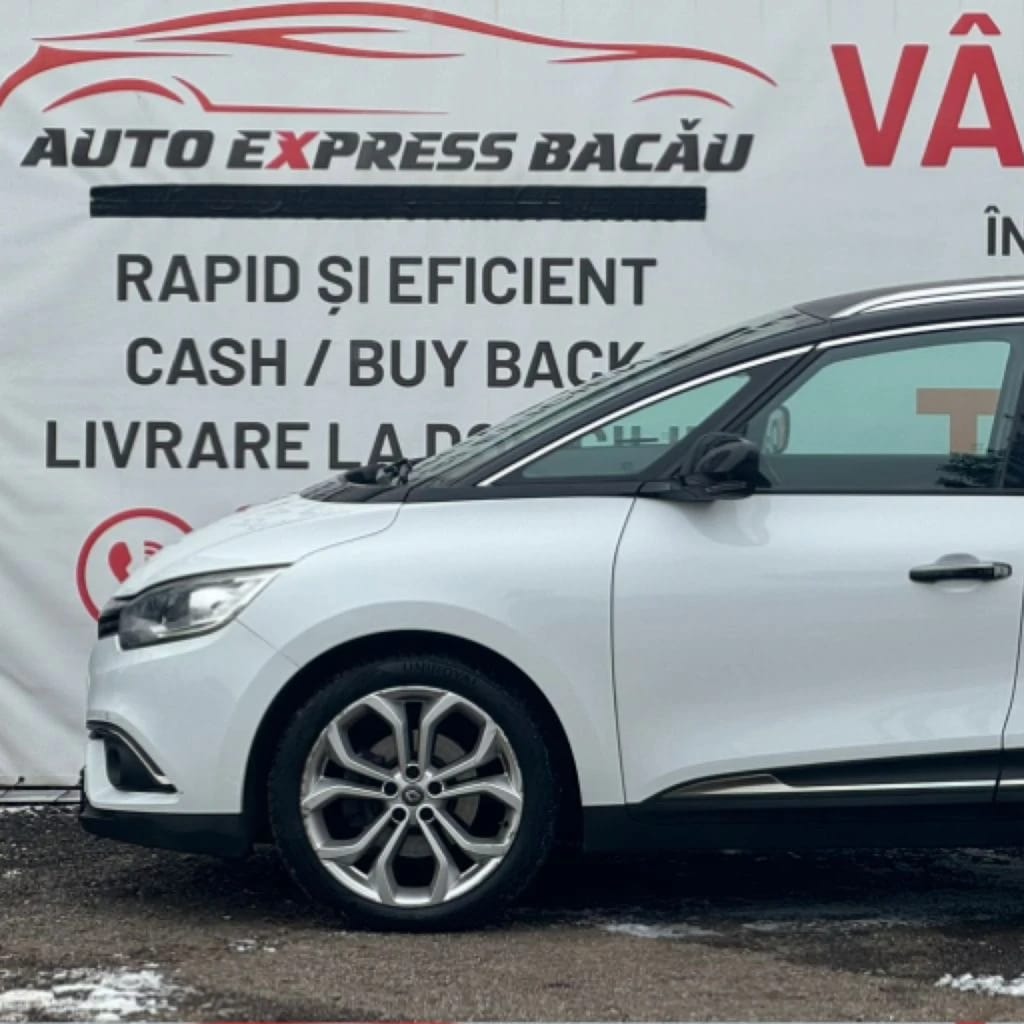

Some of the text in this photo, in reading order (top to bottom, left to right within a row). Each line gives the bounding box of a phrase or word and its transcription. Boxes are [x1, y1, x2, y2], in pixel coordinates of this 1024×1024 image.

[20, 119, 754, 173] AUTO EXPRESS BACĂU
[117, 253, 657, 316] RAPID ȘI EFICIENT
[126, 337, 287, 387] CASH
[349, 339, 468, 388] BUY
[45, 420, 310, 470] LIVRARE
[328, 422, 403, 470] LA
